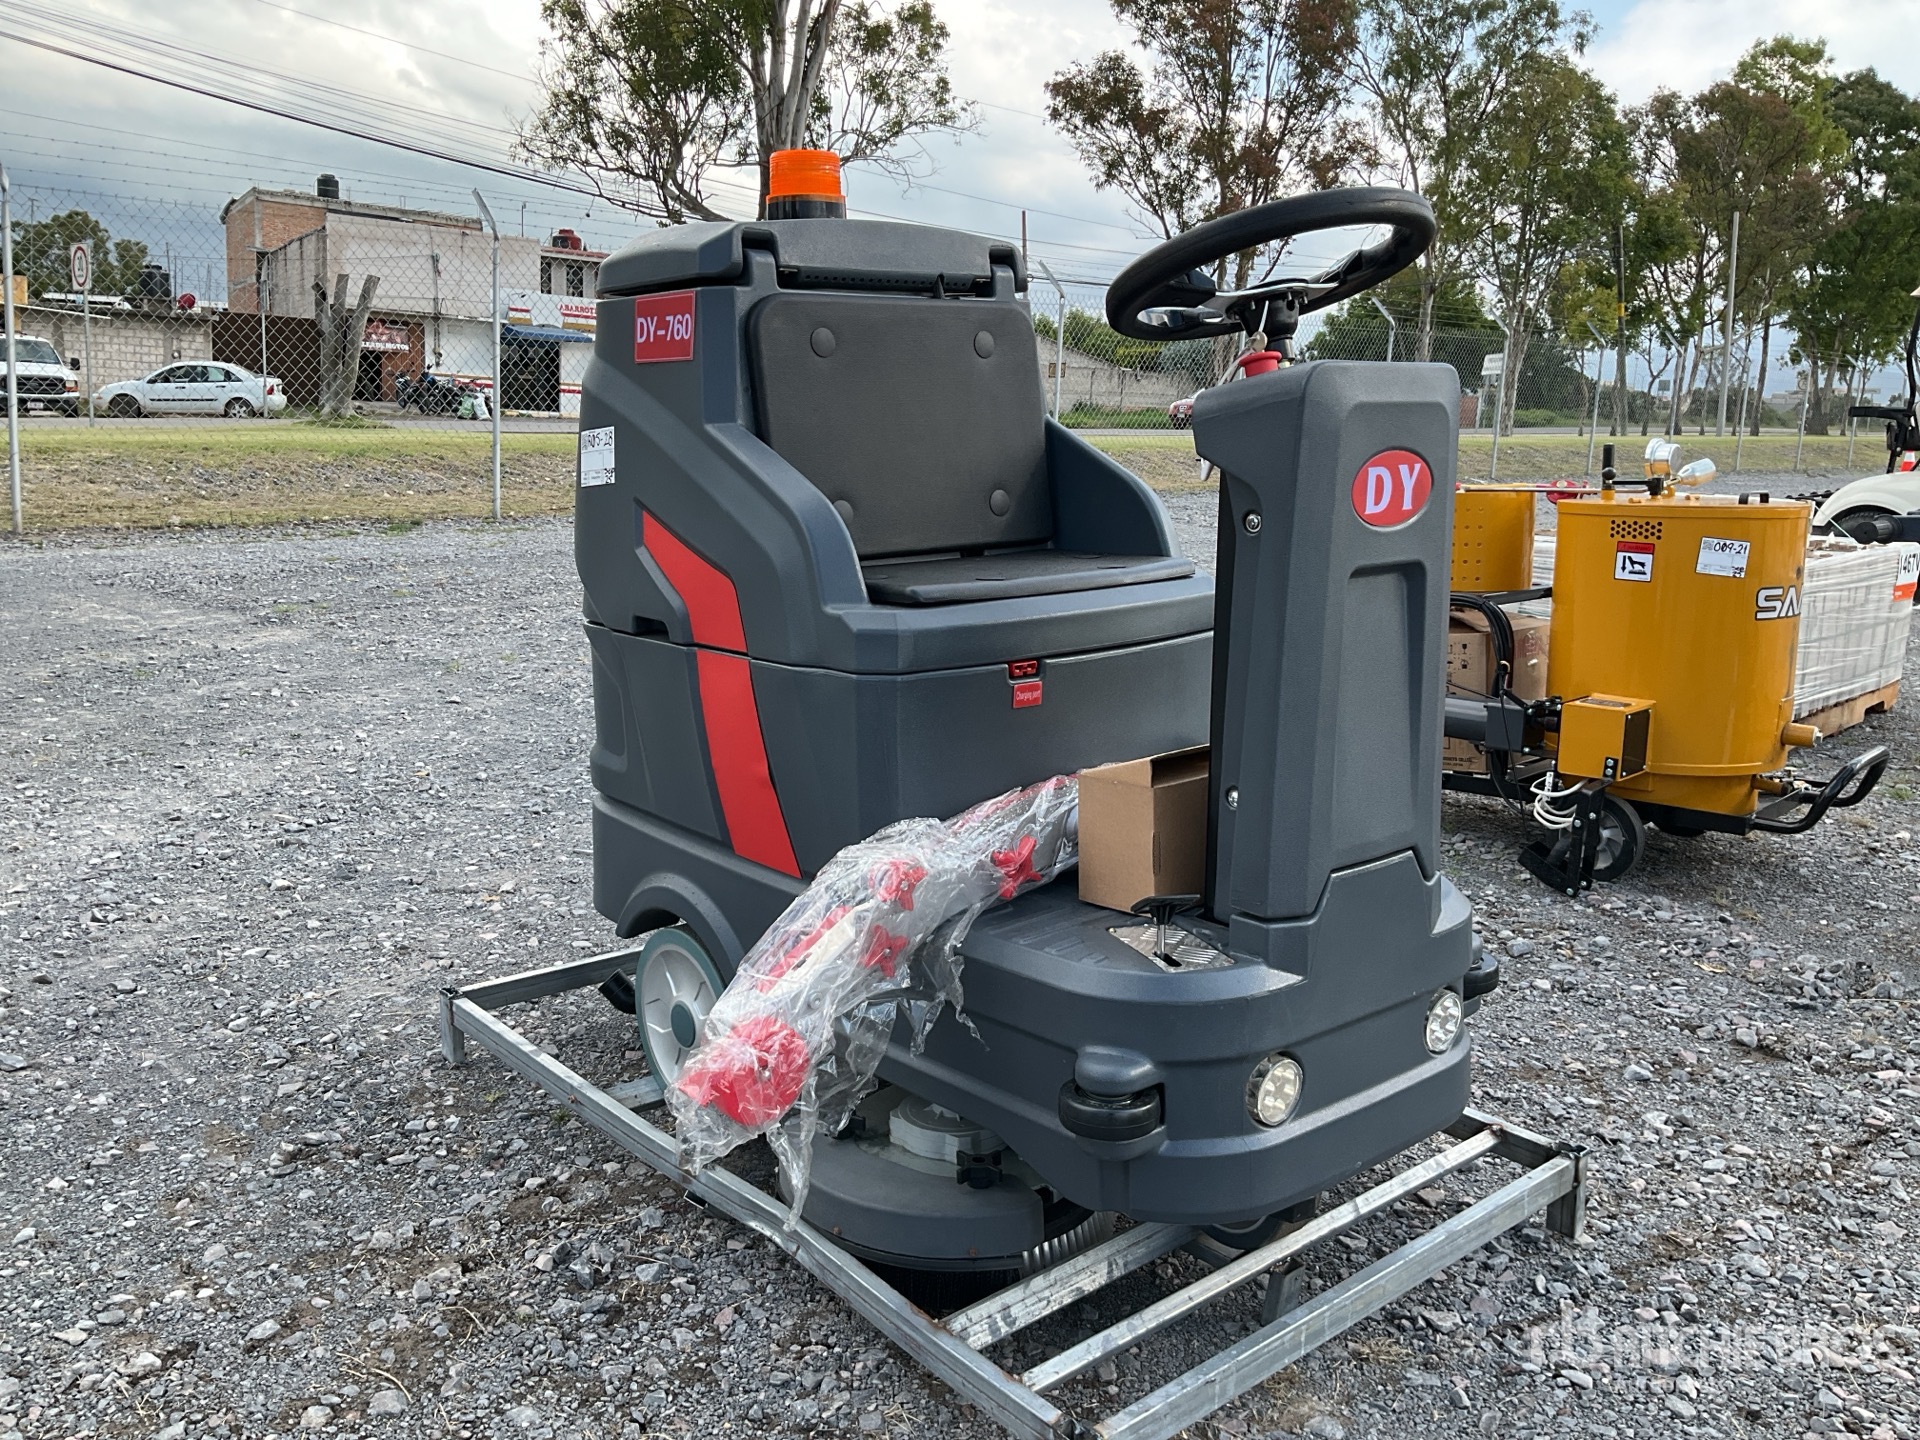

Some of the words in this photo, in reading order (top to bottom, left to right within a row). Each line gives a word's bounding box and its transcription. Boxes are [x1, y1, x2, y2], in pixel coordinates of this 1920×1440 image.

[560, 304, 596, 314] ABARROT
[637, 313, 691, 343] DY-760
[1364, 463, 1422, 514] DY
